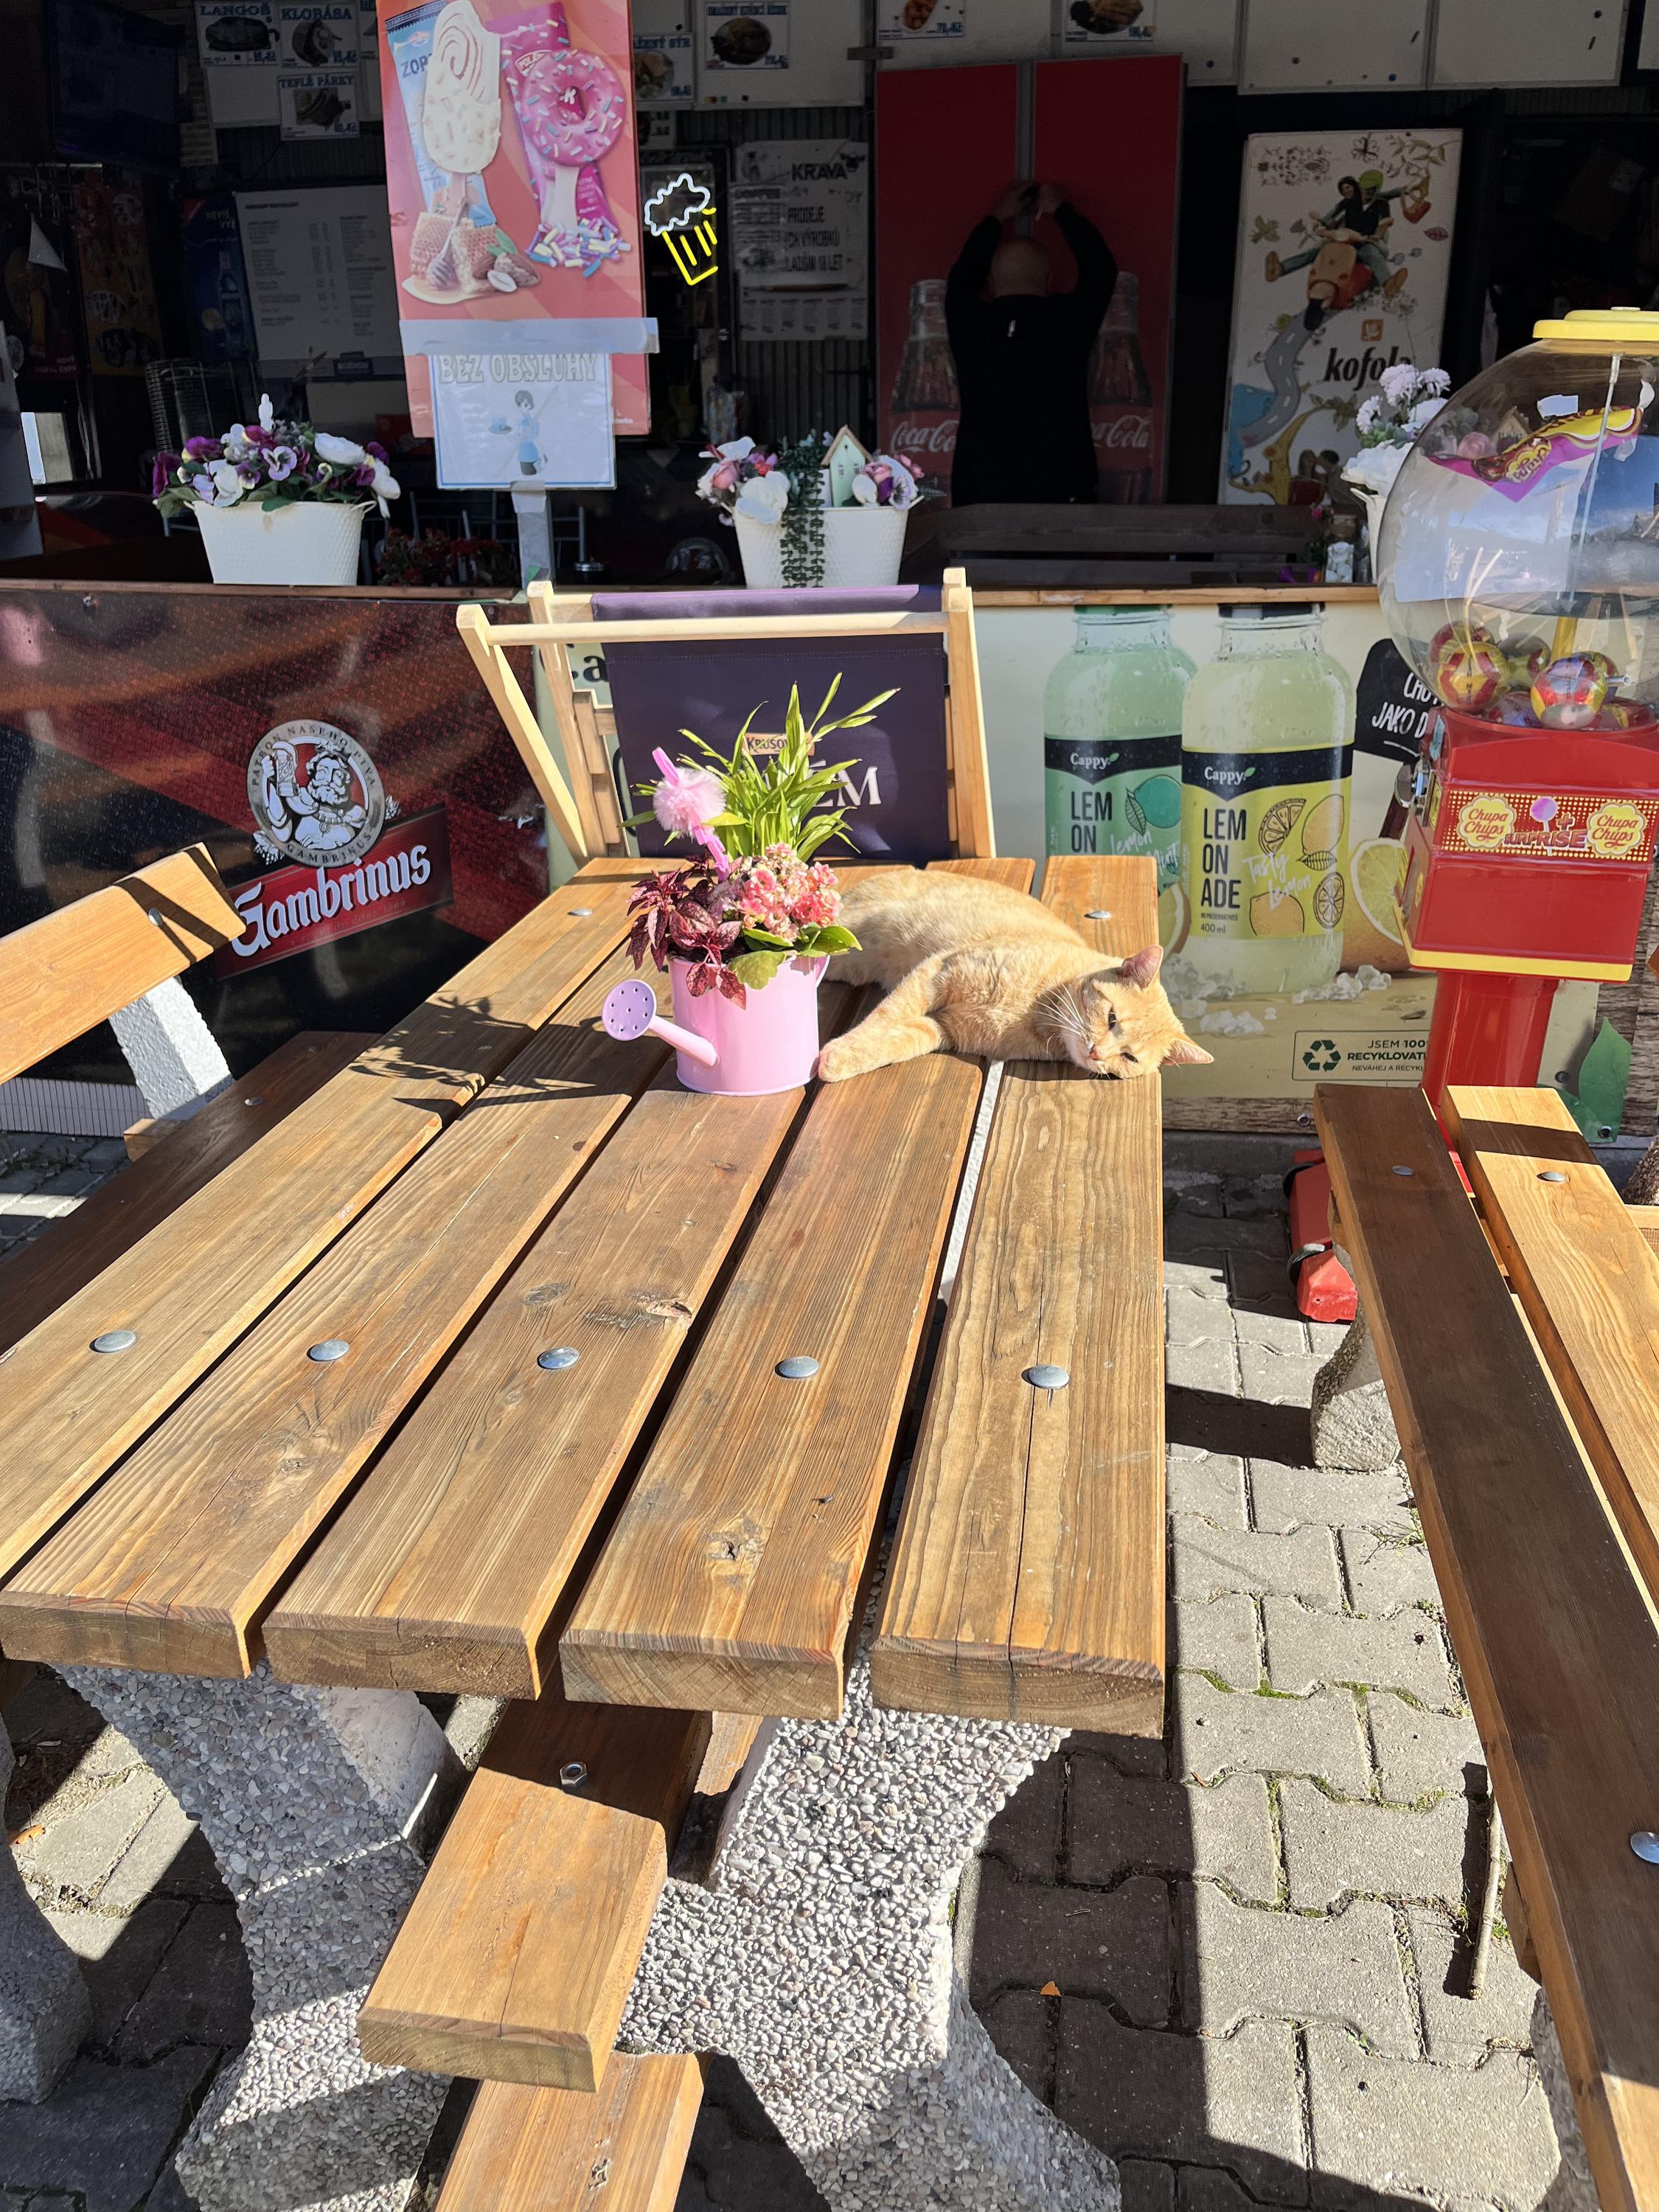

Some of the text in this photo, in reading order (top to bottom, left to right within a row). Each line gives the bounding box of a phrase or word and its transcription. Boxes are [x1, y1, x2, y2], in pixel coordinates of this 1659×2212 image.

[282, 5, 352, 21] KLOBÁSA
[438, 353, 597, 384] BEZ OBSLUHY
[1371, 702, 1416, 734] JAKO
[1071, 753, 1109, 770] Cappy
[1204, 766, 1246, 785] Cappy
[1071, 791, 1113, 822] LEM
[1468, 809, 1509, 822] Chupa
[1203, 807, 1247, 841] LEM
[1464, 821, 1506, 839] Chups
[1597, 815, 1638, 830] Chupa
[1071, 824, 1097, 853] ON
[1503, 830, 1587, 849] SURPRISE
[1591, 828, 1635, 846] Chups
[286, 834, 372, 864] GAMBRINUS
[1202, 844, 1228, 875] ON
[230, 844, 431, 957] Gambrinus
[1200, 877, 1242, 909] ADE
[1200, 922, 1216, 933] 400
[1368, 1039, 1428, 1048] JSEM 100
